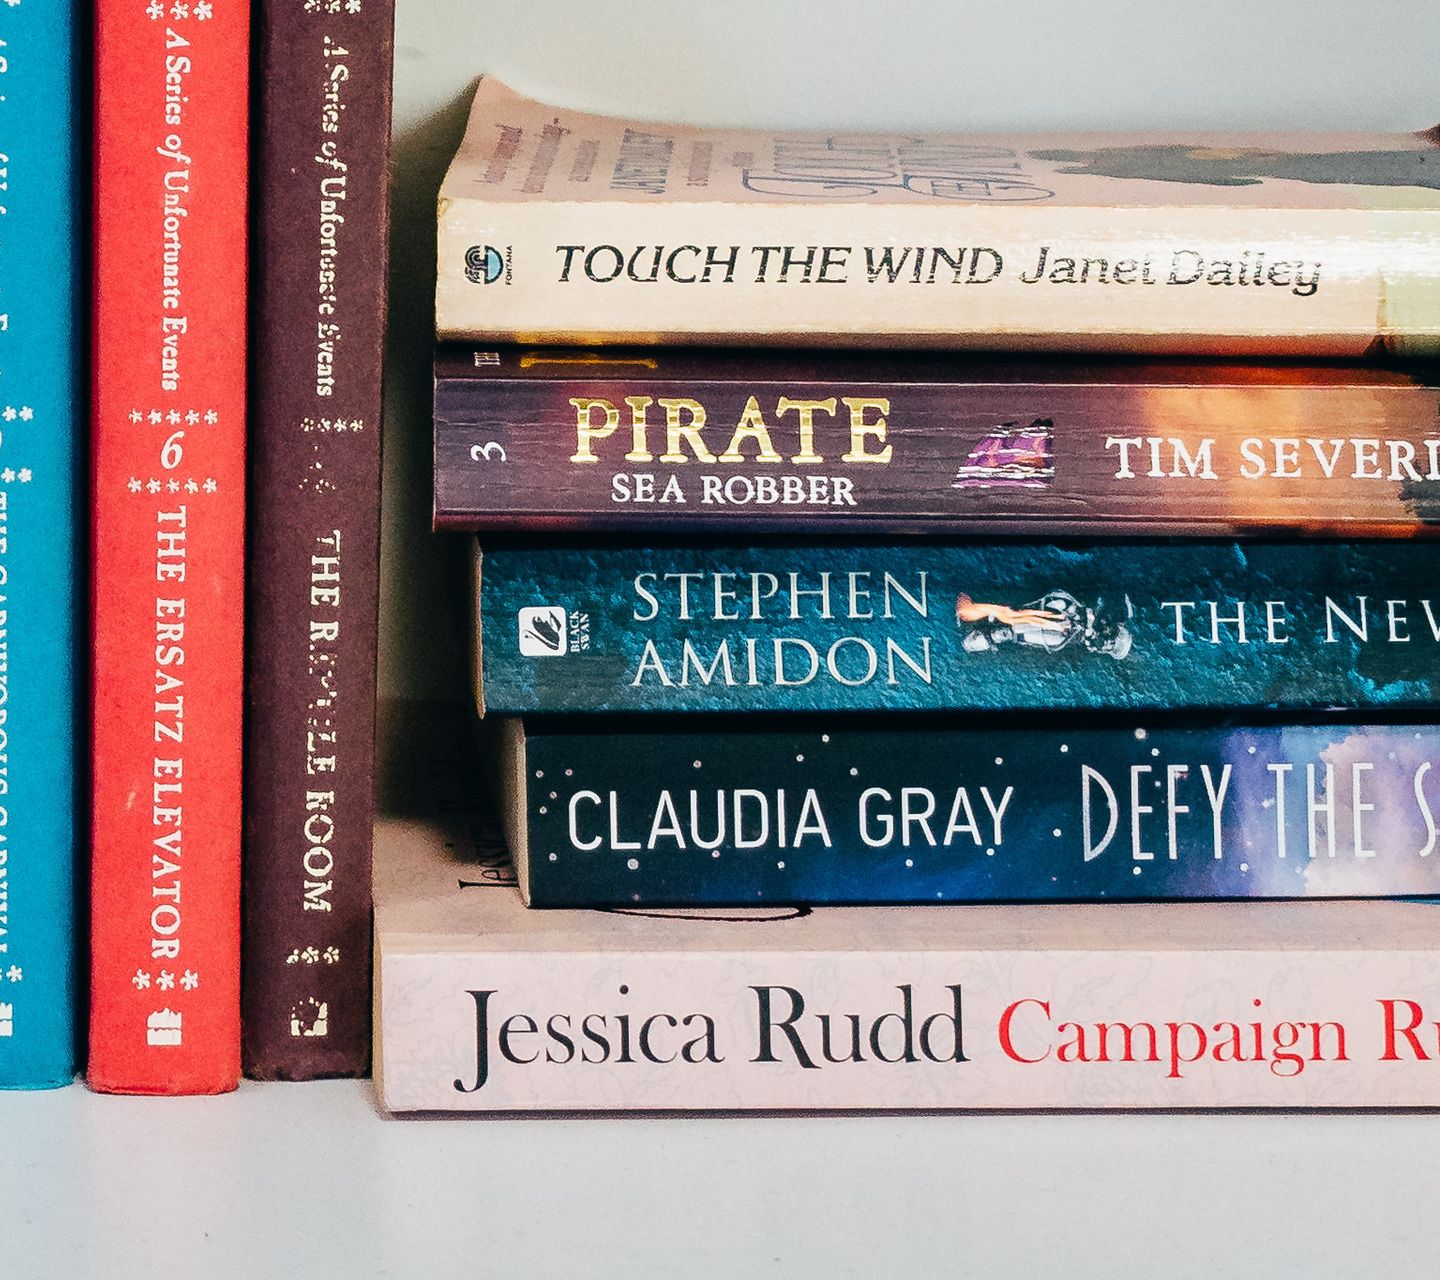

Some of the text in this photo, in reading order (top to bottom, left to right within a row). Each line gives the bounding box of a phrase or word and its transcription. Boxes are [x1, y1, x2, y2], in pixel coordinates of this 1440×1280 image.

[156, 27, 191, 392] A Series of Unfortunate Events
[556, 244, 1322, 297] TOUCH THE WIND Janet Dailey
[160, 430, 185, 470] 6
[470, 441, 506, 462] 3
[568, 395, 894, 464] PIRATE
[1104, 436, 1219, 481] TIM
[610, 473, 858, 506] SEA ROBBER
[633, 570, 929, 623] STEPHEN
[1161, 600, 1290, 645] THE
[570, 610, 580, 654] BLACK
[580, 612, 590, 651] SWAN
[630, 635, 934, 688] AMIDON
[150, 505, 187, 960] THE ERSATZ ELEVATOR
[303, 529, 341, 914] THE ROOM
[568, 787, 832, 852] CLAUDIA
[859, 785, 1013, 847] GRAY
[1081, 762, 1376, 862] DEFY THE
[453, 983, 1351, 1093] Jessica Rudd Campaign
